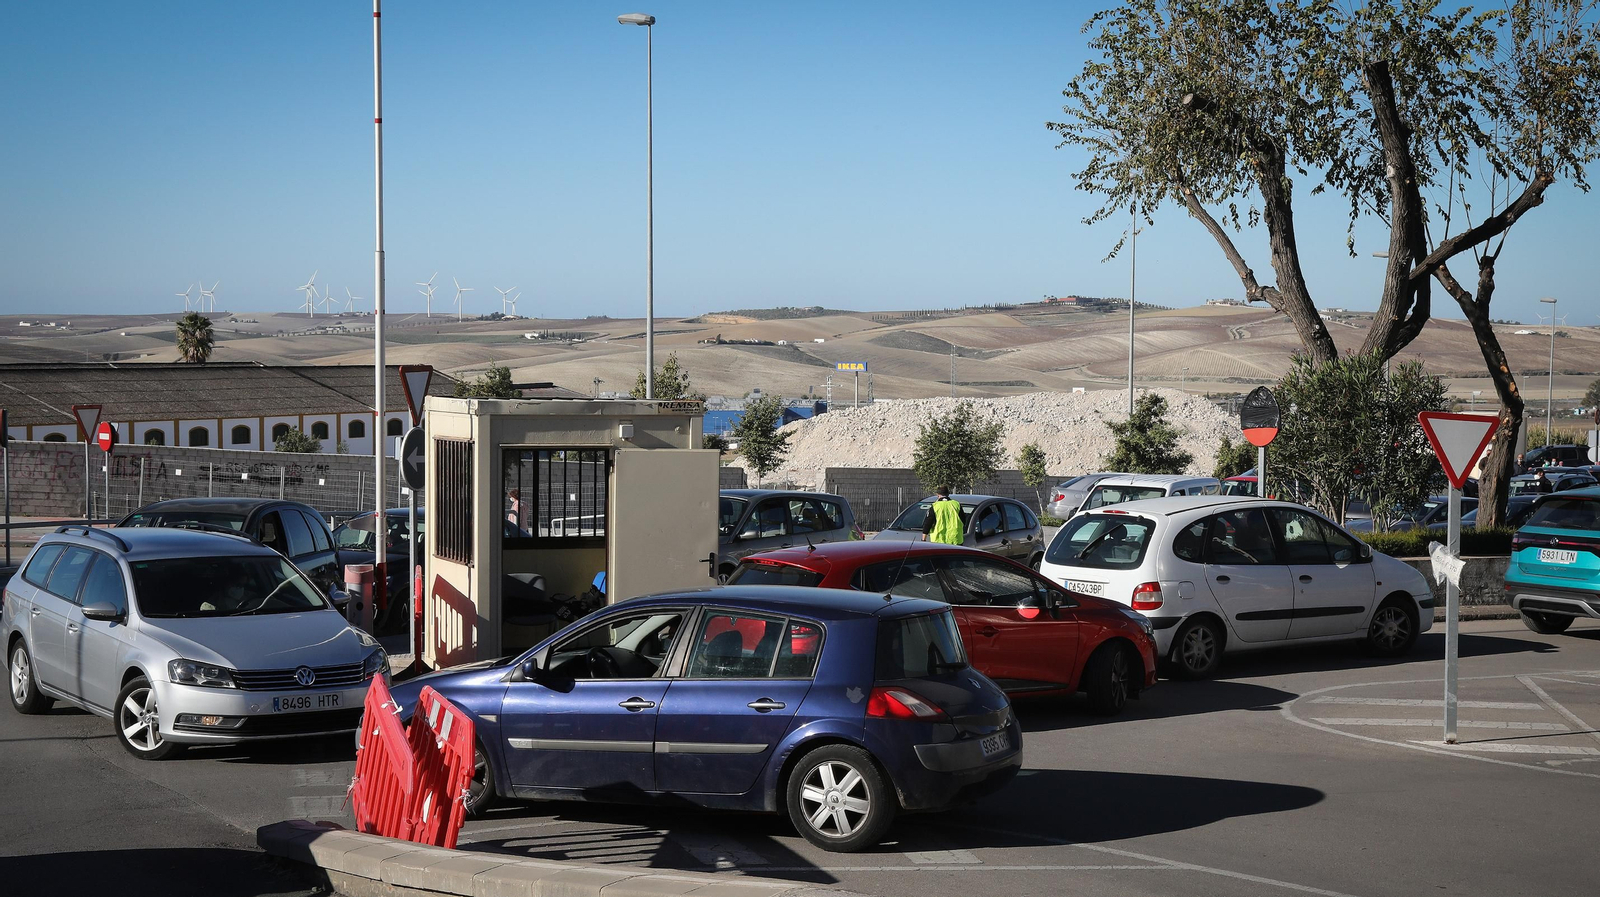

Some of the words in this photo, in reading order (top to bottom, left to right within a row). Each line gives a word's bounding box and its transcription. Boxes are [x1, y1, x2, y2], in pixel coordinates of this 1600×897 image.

[1541, 550, 1559, 560] 5931
[1560, 551, 1576, 562] LTN
[282, 696, 311, 710] 8496
[318, 694, 339, 708] HTR
